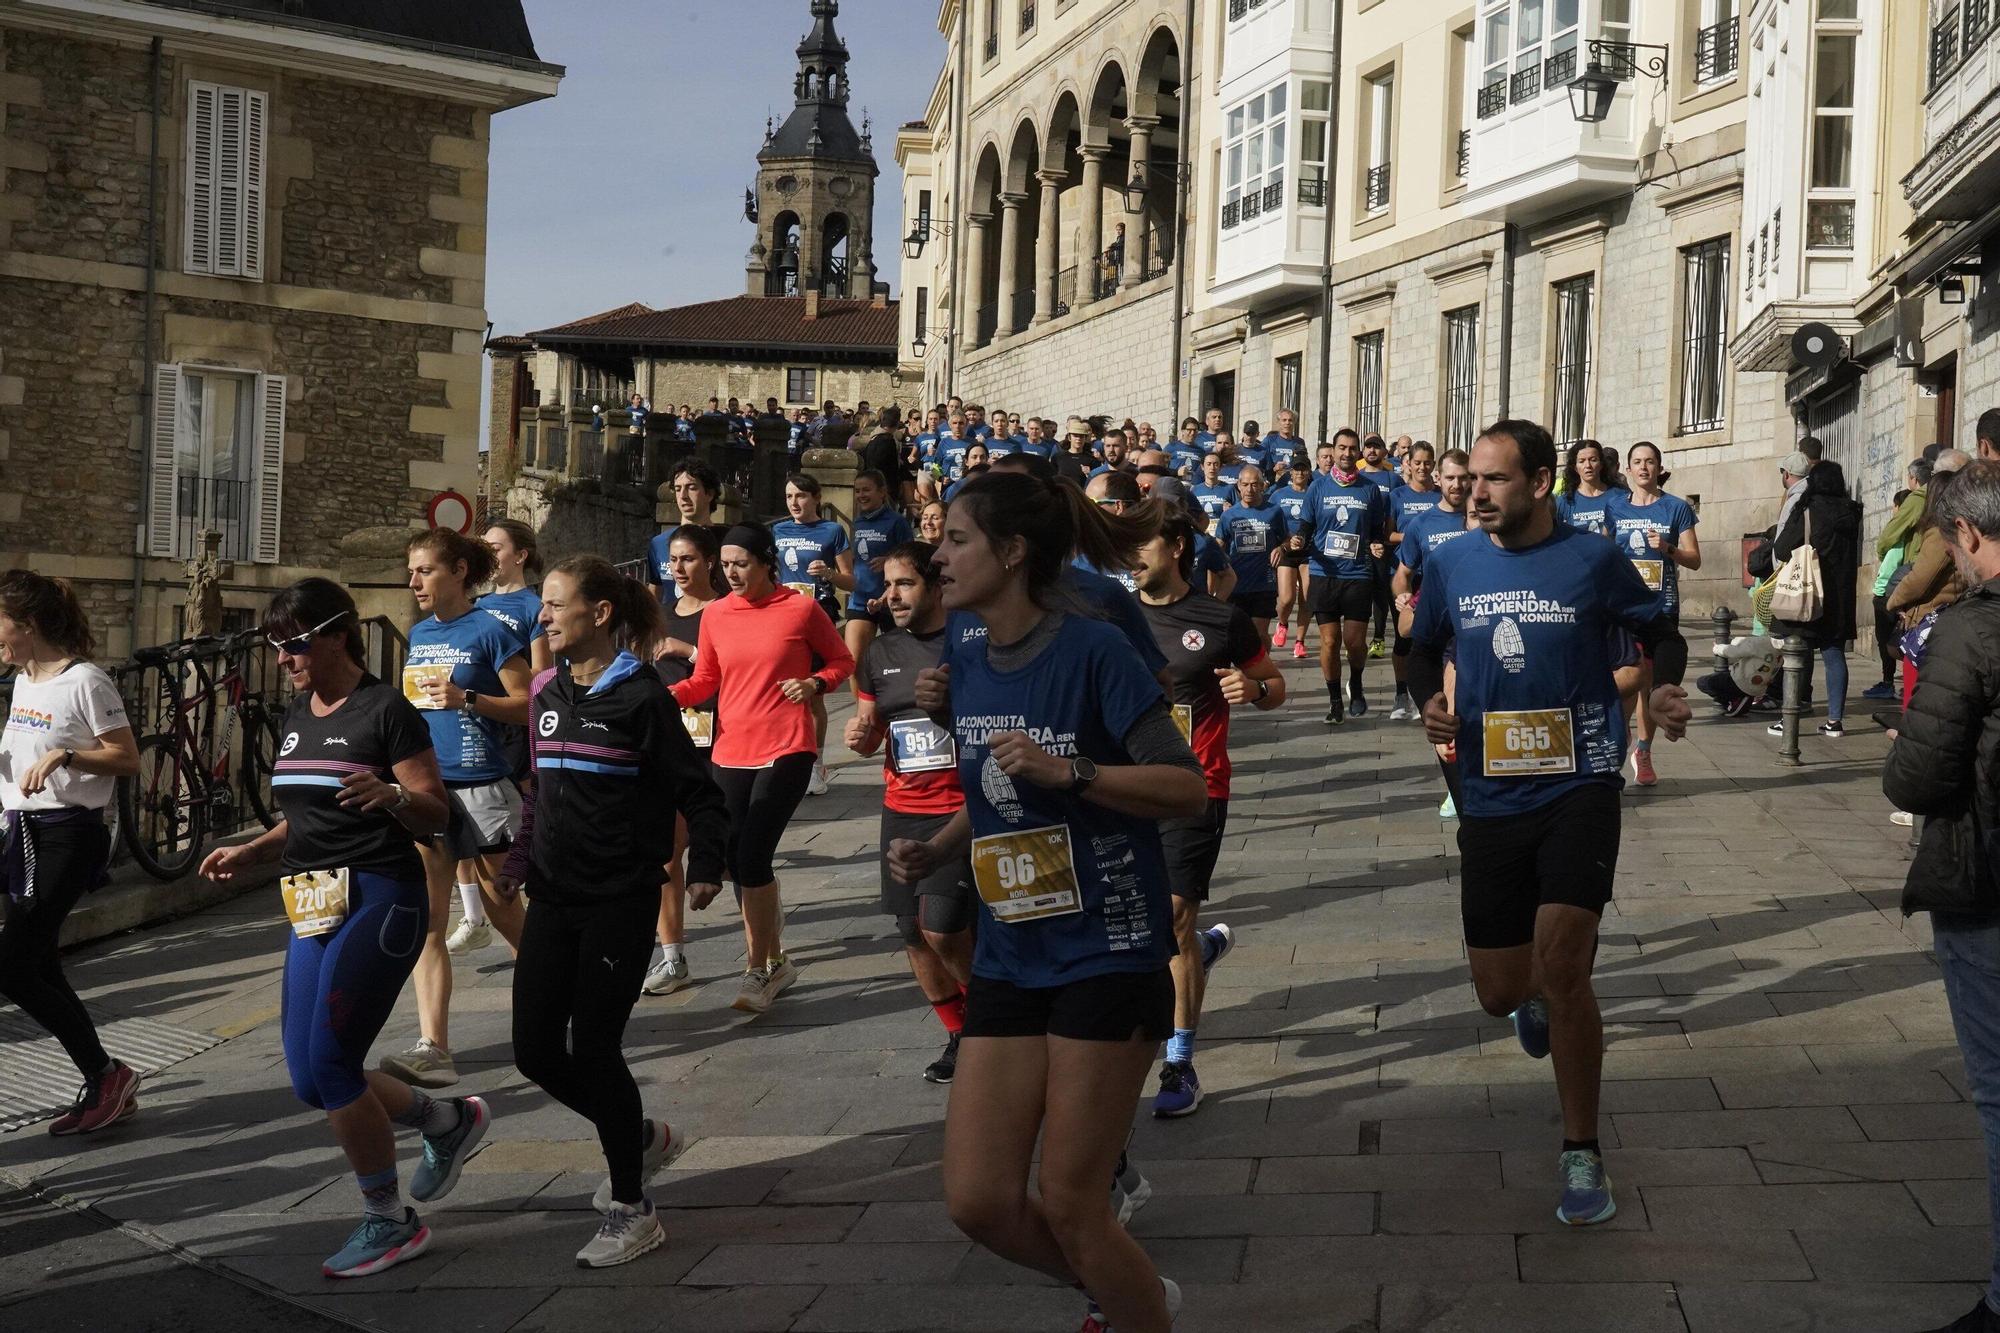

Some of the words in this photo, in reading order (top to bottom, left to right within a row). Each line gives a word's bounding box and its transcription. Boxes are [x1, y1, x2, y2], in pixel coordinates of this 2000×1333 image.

[1925, 386, 1932, 396] 2
[1334, 538, 1350, 548] 978
[1459, 596, 1471, 606] LA
[1472, 590, 1536, 604] CONQUISTA
[1474, 600, 1561, 617] ALMENDRA
[1520, 613, 1576, 623] KONKISTA
[956, 716, 965, 728] LA
[966, 715, 1026, 728] CONQUISTA
[905, 731, 936, 753] 951
[1056, 733, 1075, 742] REN
[1506, 726, 1550, 751] 655
[1048, 834, 1063, 844] 10K
[997, 853, 1035, 888] 96
[295, 887, 326, 913] 220
[1009, 889, 1029, 899] NORA
